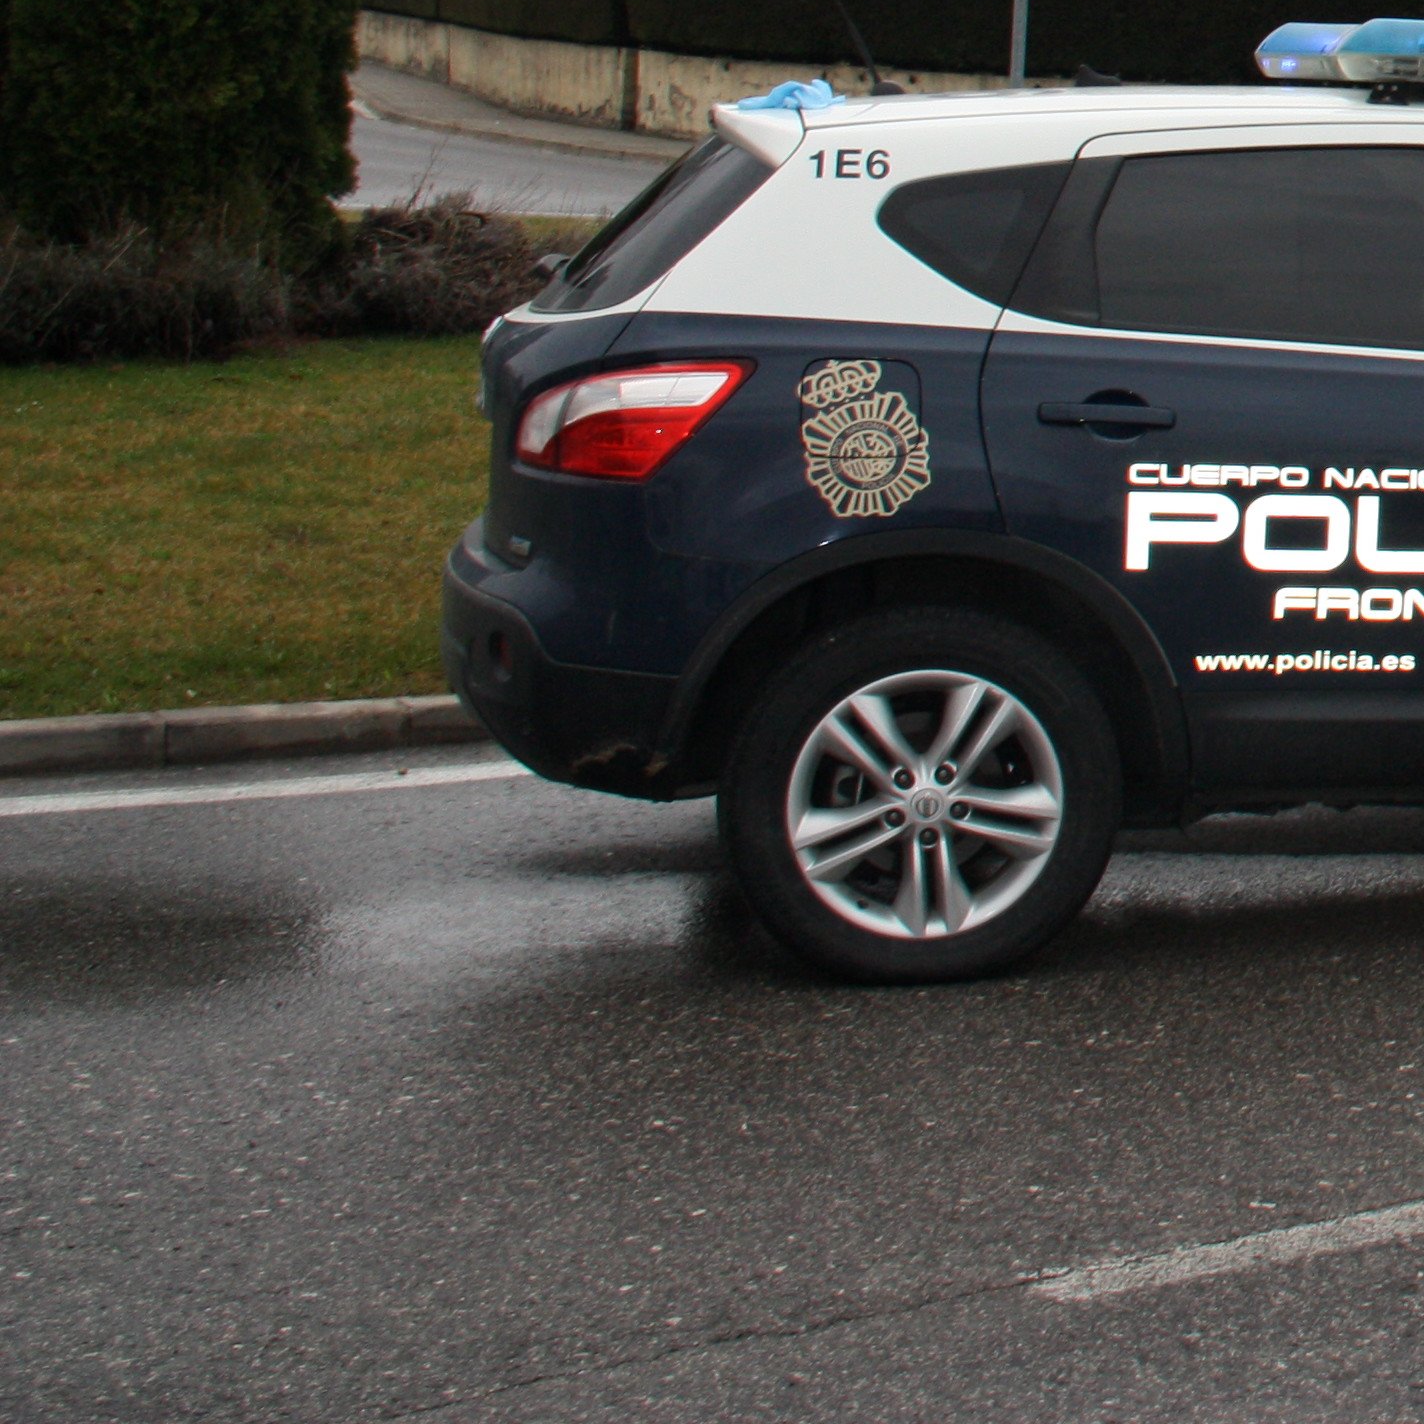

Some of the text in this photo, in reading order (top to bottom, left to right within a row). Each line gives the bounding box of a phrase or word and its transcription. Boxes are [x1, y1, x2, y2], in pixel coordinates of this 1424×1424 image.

[808, 148, 892, 180] 1E6
[1127, 463, 1311, 488] CUERPO
[1192, 649, 1416, 676] www.policia.es
